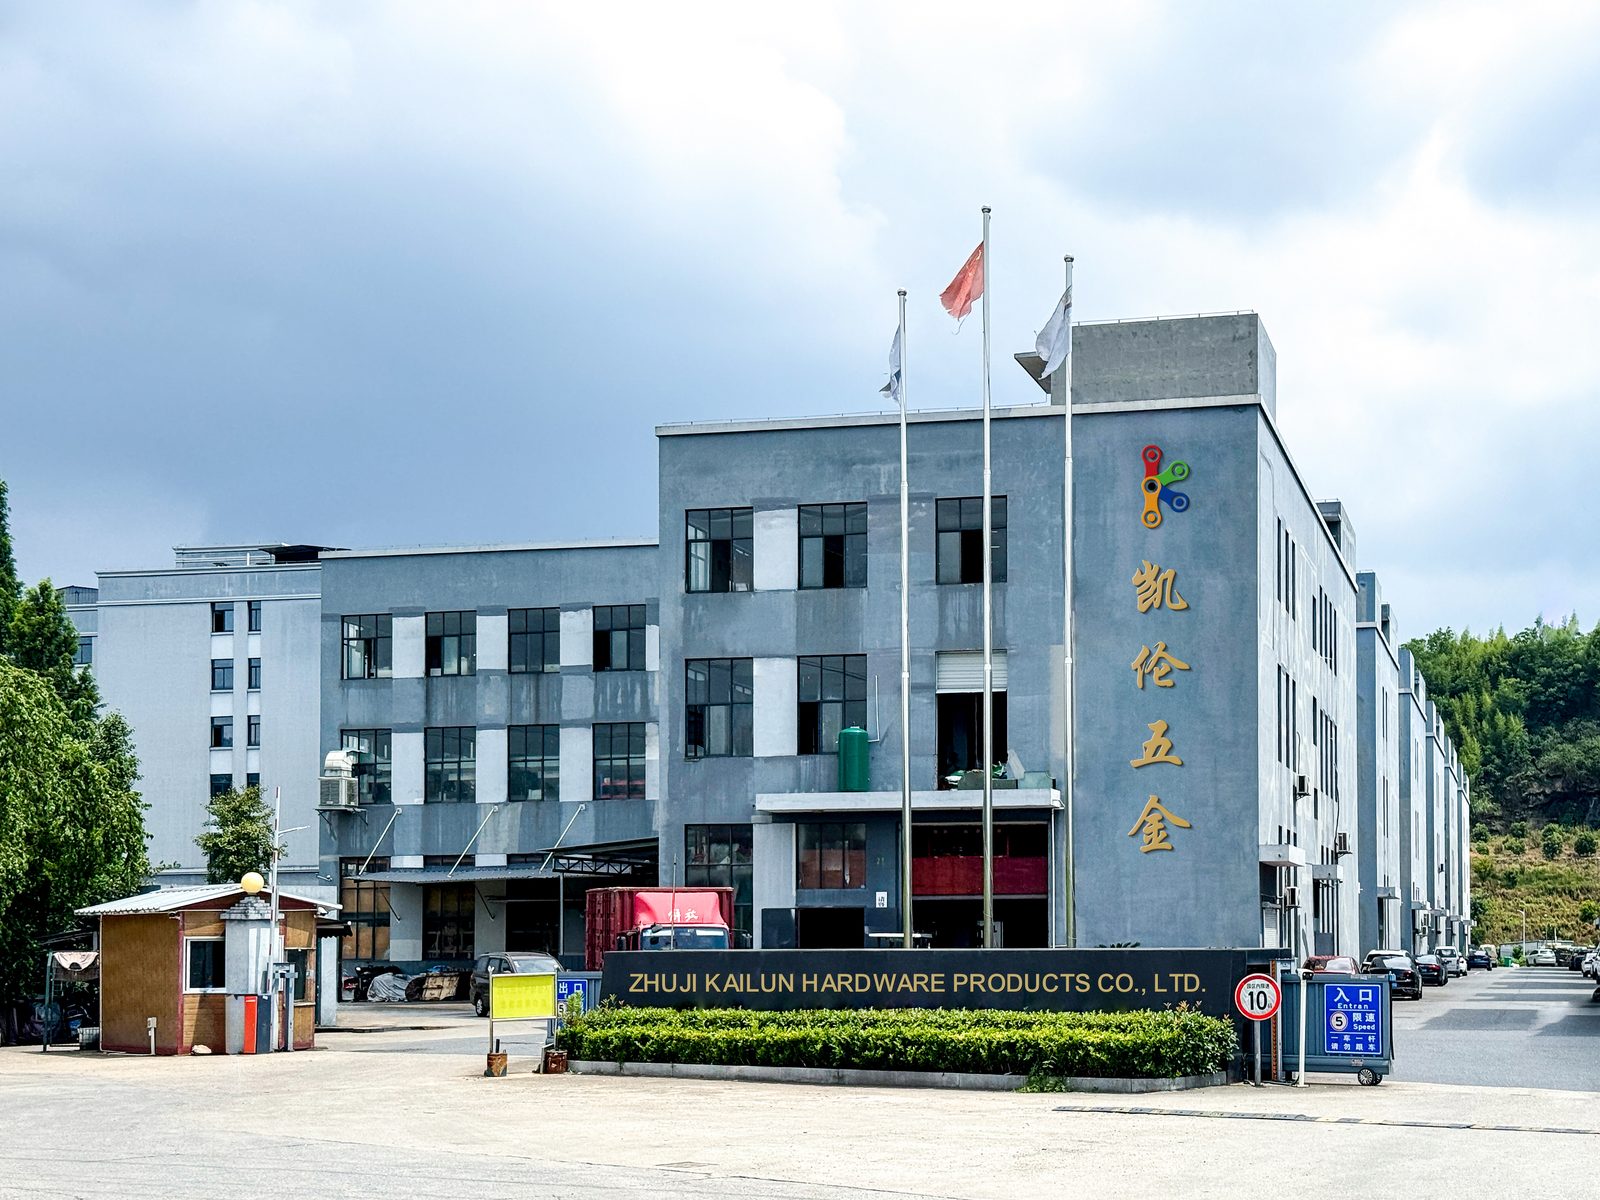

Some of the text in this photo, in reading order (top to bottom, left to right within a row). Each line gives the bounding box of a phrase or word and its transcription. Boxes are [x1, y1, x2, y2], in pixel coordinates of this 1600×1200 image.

[1128, 558, 1191, 853] 凯伦五金
[558, 981, 583, 994] 出口
[629, 973, 697, 993] ZHUJI
[705, 973, 794, 993] KAILUN
[802, 973, 945, 993] HARDWARE
[953, 973, 1090, 993] PRODUCTS
[1248, 990, 1267, 1010] 10
[1333, 987, 1373, 1002] 入口
[1335, 1016, 1343, 1027] 5
[1352, 1012, 1376, 1023] 限速
[1353, 1023, 1376, 1031] Speed
